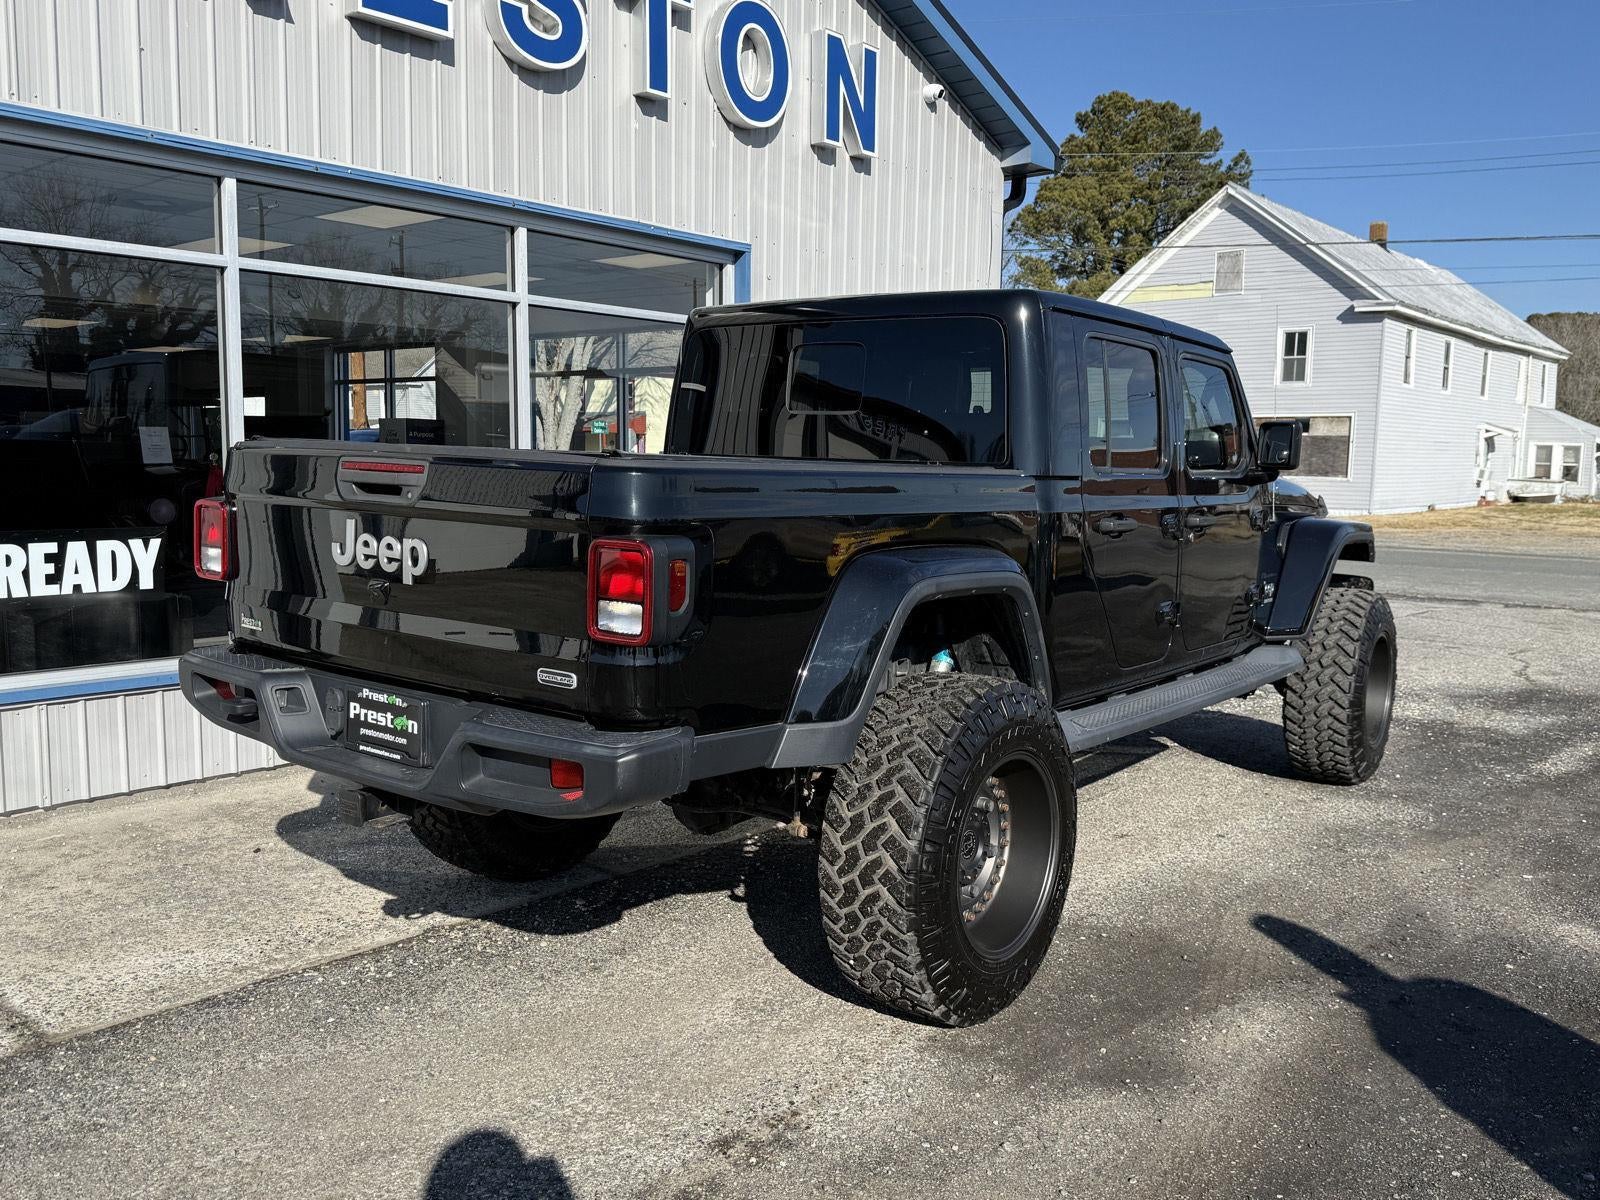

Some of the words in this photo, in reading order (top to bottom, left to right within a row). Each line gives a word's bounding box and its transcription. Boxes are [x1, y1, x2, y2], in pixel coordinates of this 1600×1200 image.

[348, 0, 880, 158] STON
[0, 538, 162, 598] READY
[331, 518, 429, 585] Jeep
[538, 673, 574, 684] OVERLAND
[359, 744, 401, 760] prestonmotor.com
[360, 727, 408, 745] prestonmotor.com
